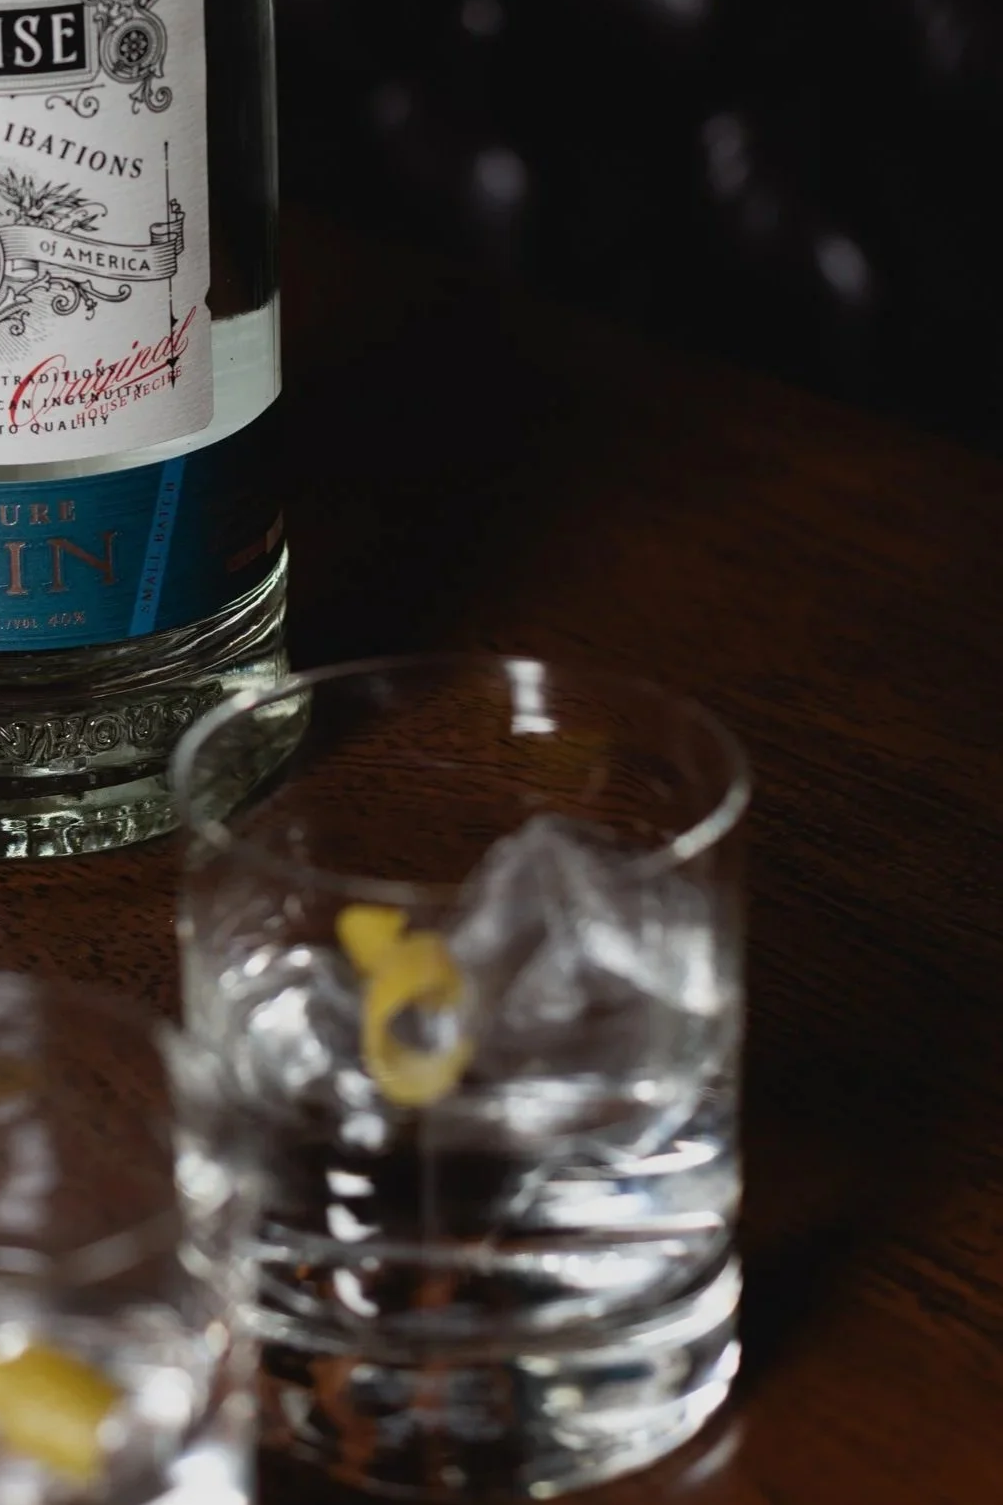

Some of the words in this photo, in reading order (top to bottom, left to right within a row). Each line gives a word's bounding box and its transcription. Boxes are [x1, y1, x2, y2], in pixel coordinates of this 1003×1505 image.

[63, 247, 151, 271] AMERICA
[8, 306, 196, 429] Original
[30, 414, 109, 435] QUALITY
[76, 395, 127, 426] HOUSE
[142, 556, 161, 614] SMALL
